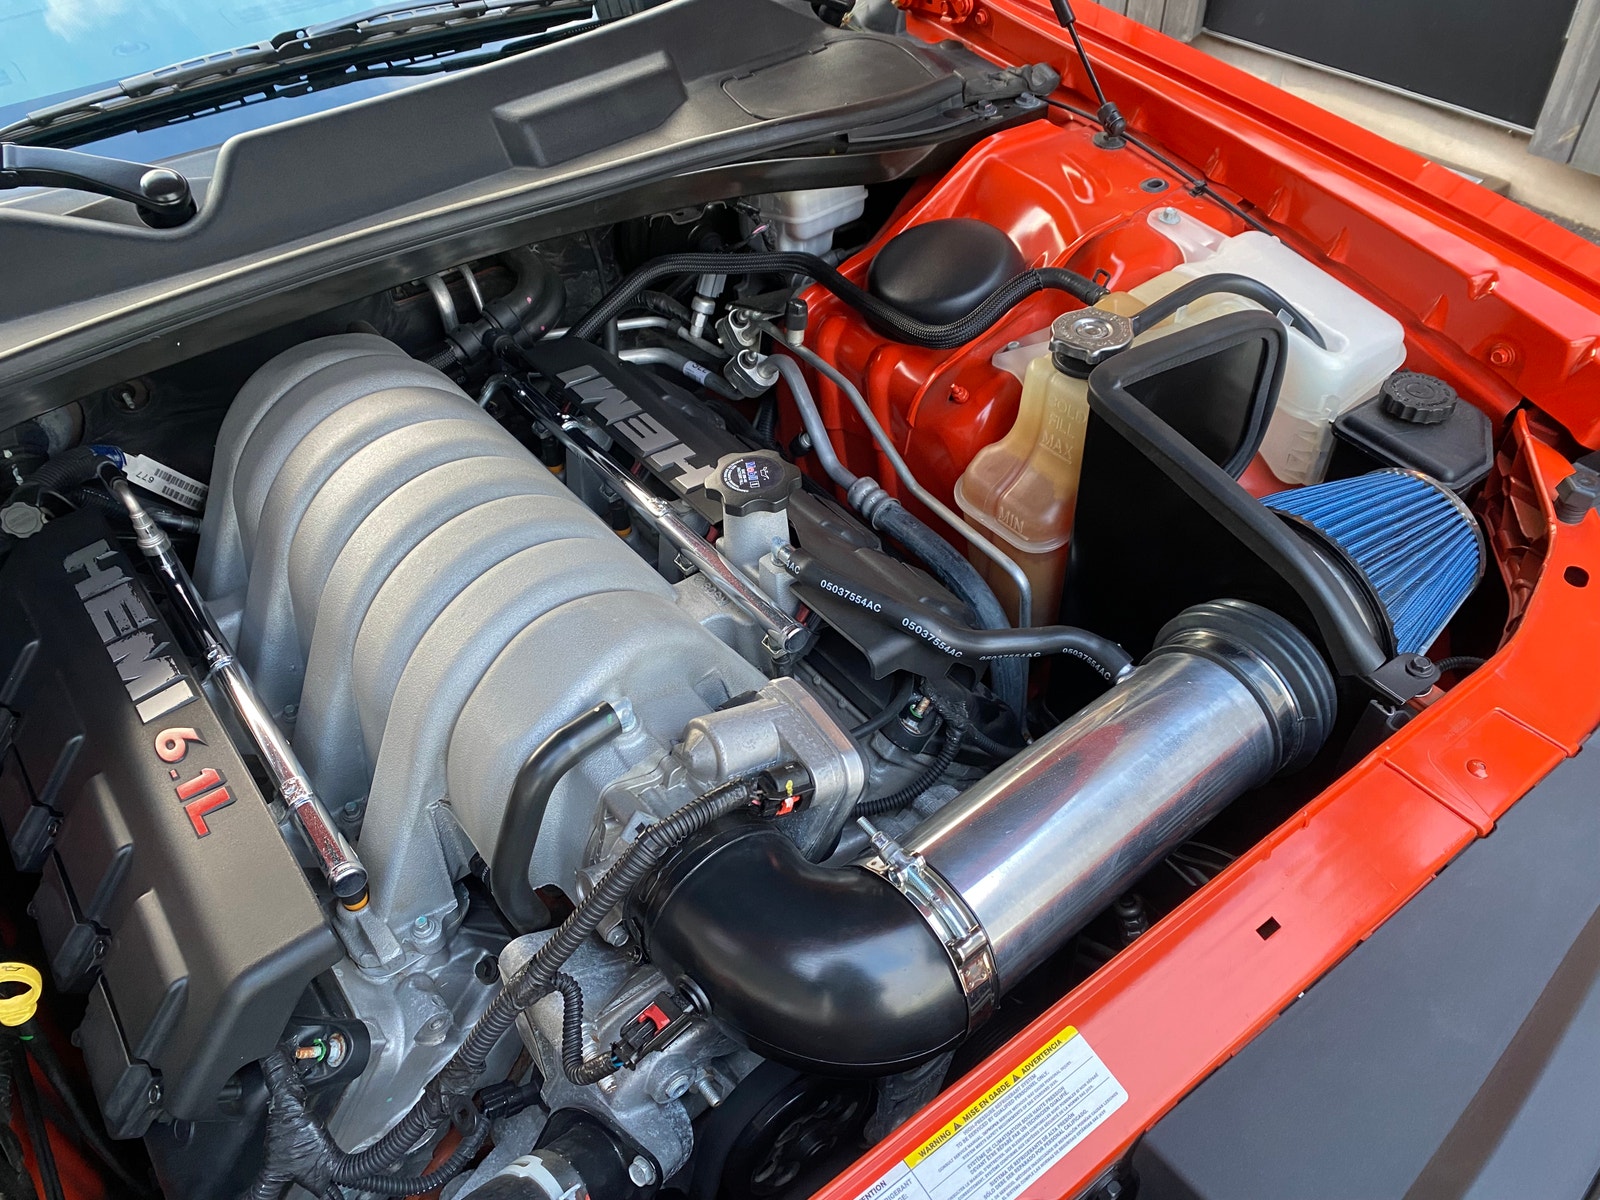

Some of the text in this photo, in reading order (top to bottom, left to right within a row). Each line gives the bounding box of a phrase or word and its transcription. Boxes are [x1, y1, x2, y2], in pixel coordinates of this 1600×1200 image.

[556, 365, 715, 493] HEMI
[1042, 432, 1073, 459] MAX
[1049, 414, 1075, 437] FILL
[135, 469, 154, 484] 677
[998, 506, 1025, 534] MIN
[820, 579, 882, 613] 05037554AC
[63, 539, 199, 724] HEMI
[901, 617, 963, 659] 05037554AC
[1062, 647, 1111, 681] 05037554AC
[155, 727, 235, 838] 6.1L
[917, 1038, 1063, 1157] WARNING MISE EN GARDE ADVERTENCIA
[967, 1120, 988, 1138] SERVICED
[993, 1098, 1014, 1117] QUALIFIED
[1013, 1079, 1037, 1100] PERSONNEL
[1036, 1070, 1049, 1081] ONLY.
[982, 1108, 1088, 1199] SÓLO DEBE SER REPARADO POR PERSONAL CALIFICADO.
[988, 1169, 1007, 1186] SISTEMA
[1012, 1139, 1042, 1166] REFRIGERANTE
[1047, 1126, 1058, 1136] ALTA
[1056, 1111, 1075, 1128] PRESIÓN
[859, 1180, 887, 1200] ENTION
